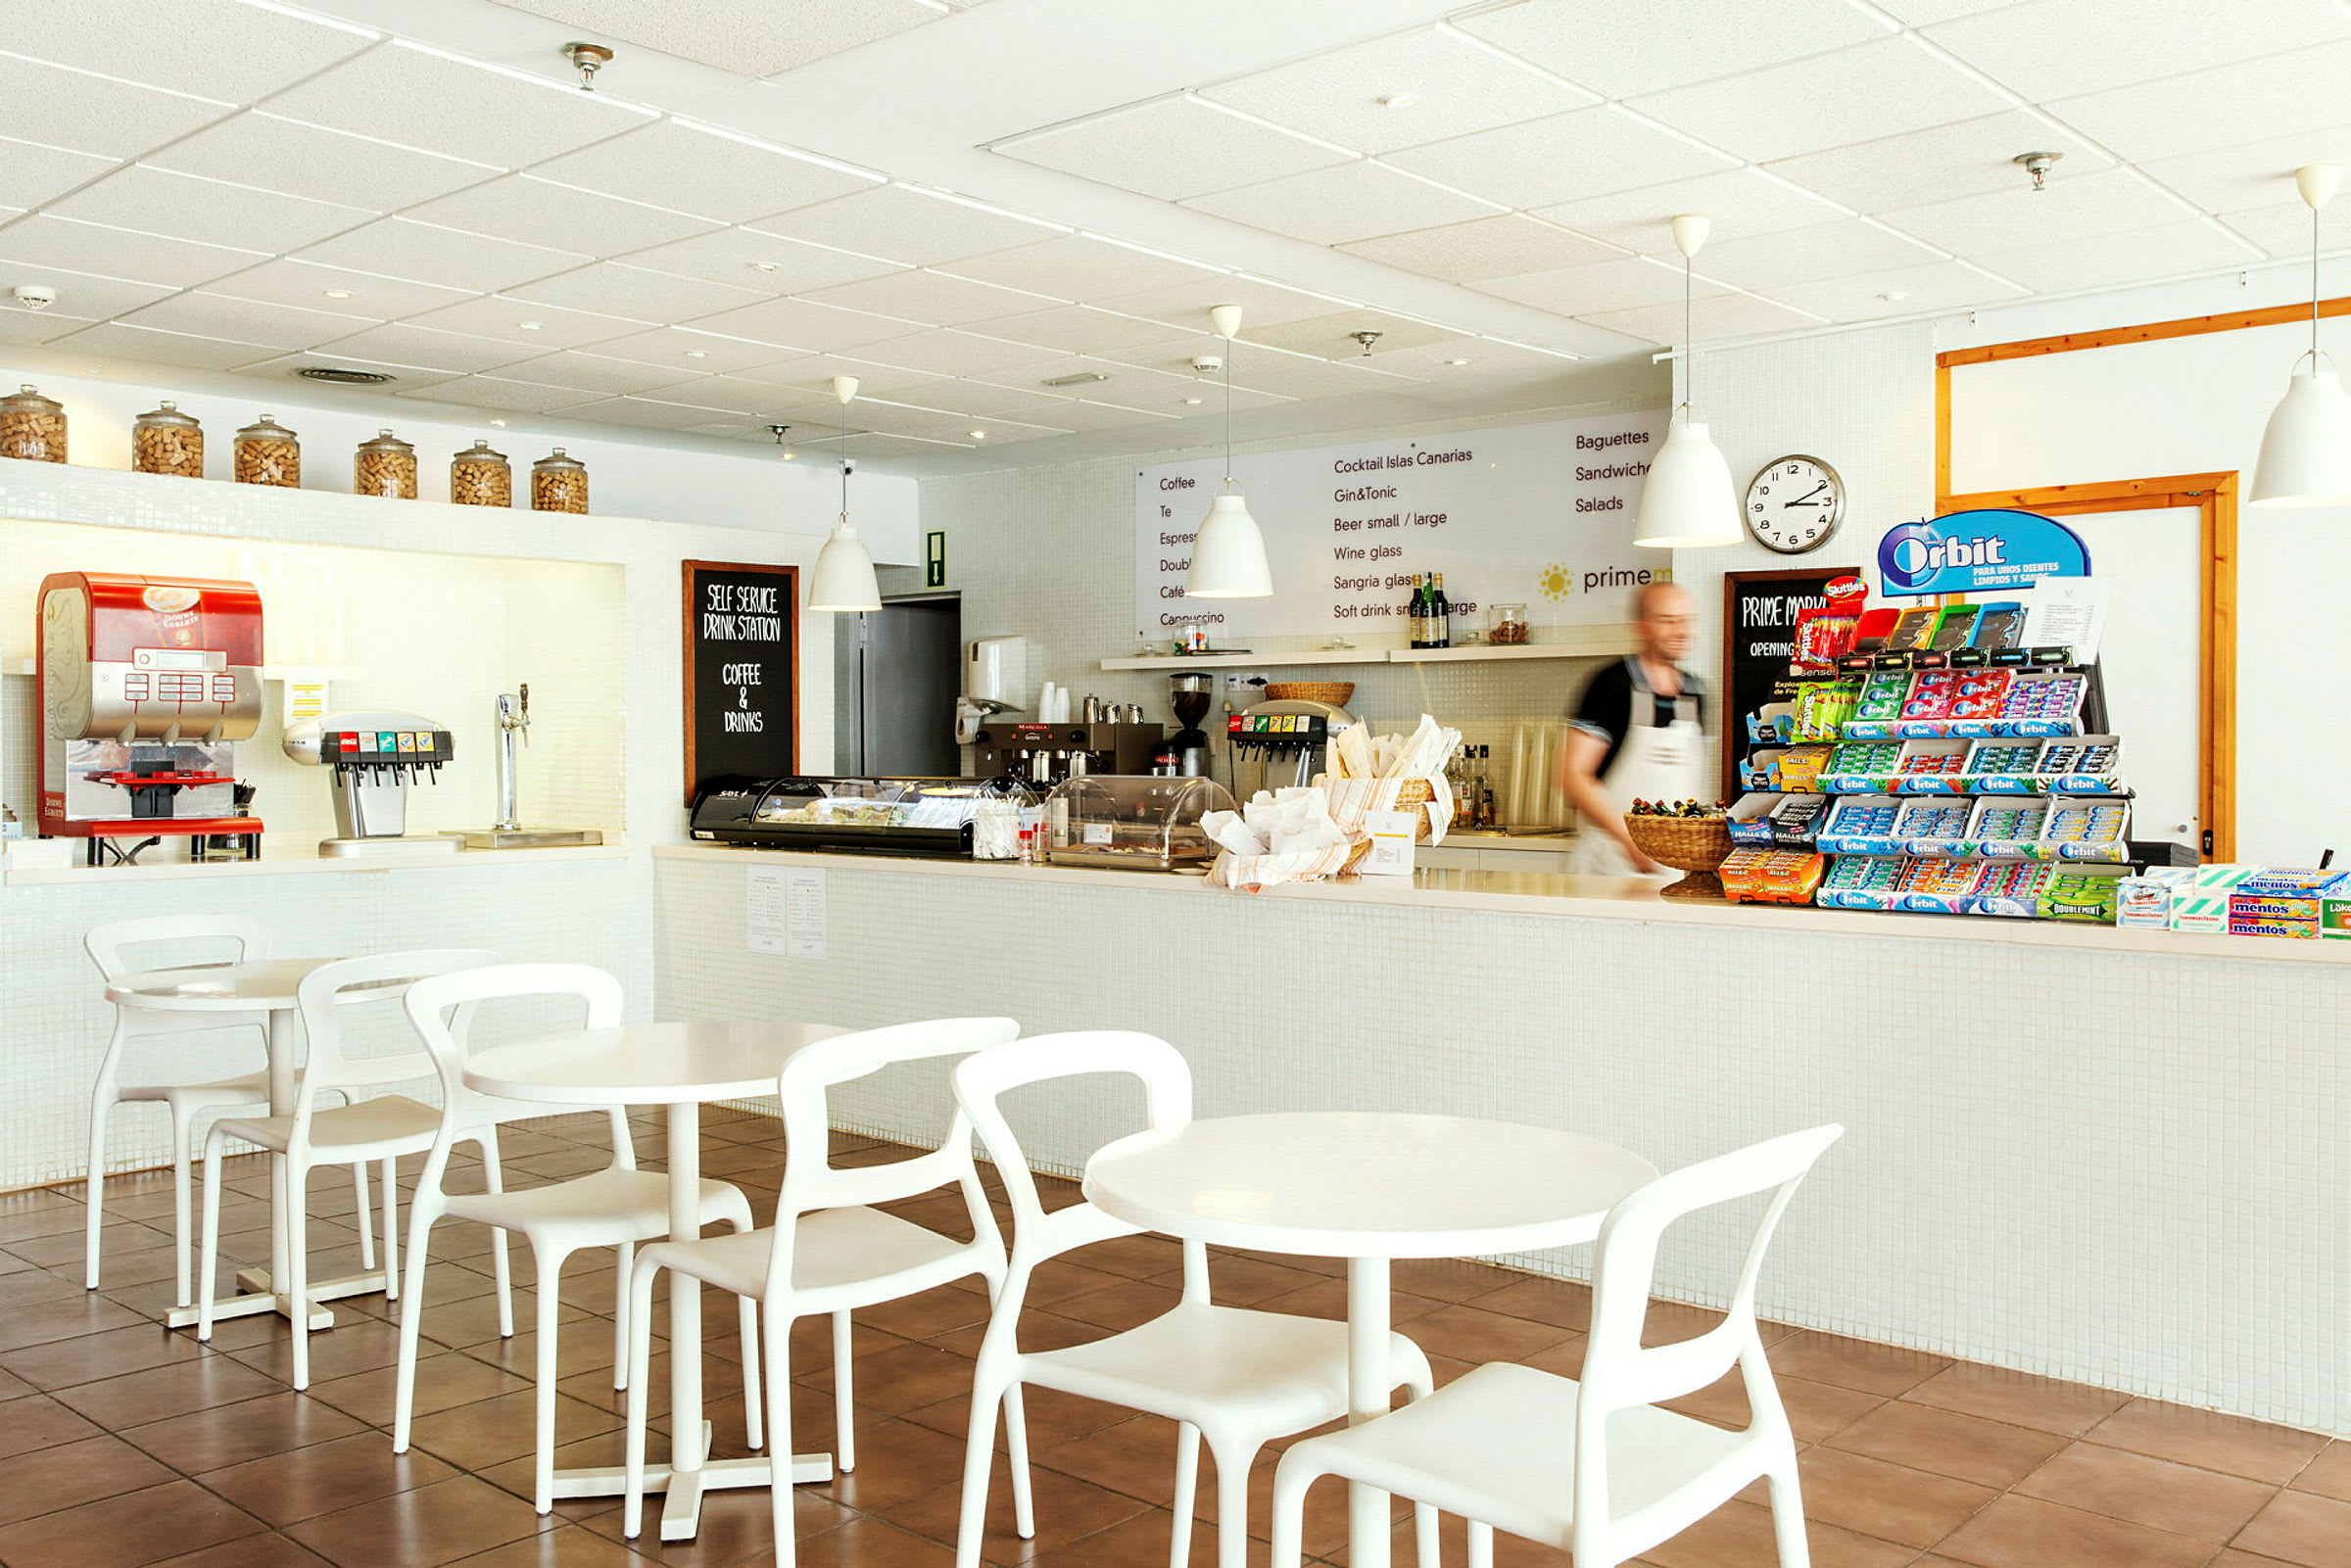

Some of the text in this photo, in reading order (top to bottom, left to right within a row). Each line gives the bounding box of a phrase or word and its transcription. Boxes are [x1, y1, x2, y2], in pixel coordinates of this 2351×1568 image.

[1575, 432, 1650, 451] Baguettes
[1334, 449, 1472, 473] Cocktail Islas Canarias
[1575, 461, 1652, 481] Sandwich
[1787, 465, 1799, 474] 12
[1807, 468, 1811, 477] 1
[1160, 477, 1195, 490] Coffee
[1771, 472, 1778, 482] 11
[1334, 486, 1398, 502] Gin&Tonic
[1759, 486, 1769, 496] 10
[1575, 496, 1624, 512] Salads
[1754, 503, 1764, 512] 9
[1823, 498, 1832, 506] 3
[1160, 505, 1172, 517] Te
[1334, 519, 1363, 532] Beer
[1367, 514, 1400, 529] small
[1414, 512, 1448, 528] large
[1759, 520, 1770, 529] 8
[1818, 514, 1827, 523] 4
[1160, 532, 1198, 546] Espres
[1772, 532, 1781, 542] 7
[1789, 536, 1799, 545] 6
[1805, 529, 1815, 538] 5
[1334, 545, 1403, 561] Wine glass
[1878, 523, 2006, 588] Orbit
[1160, 558, 1192, 572] Doubl
[1973, 566, 1996, 577] PARA
[2022, 561, 2060, 573] DIENTES
[1334, 573, 1412, 592] Sangria glas
[1973, 574, 2011, 587] LIMPIOS
[1160, 587, 1184, 598] Café
[1828, 582, 1865, 597] Skittles
[707, 584, 778, 614] SELF SERVICE
[1334, 604, 1358, 618] Soft
[1361, 603, 1391, 617] drink
[1447, 602, 1477, 616] arge
[1742, 596, 1784, 627] PRIME
[703, 613, 781, 641] DRINK STATION
[1800, 622, 1813, 661] Skittles
[1750, 642, 1795, 656] OPENING
[723, 663, 761, 686] COFFEE
[739, 687, 747, 710] &
[725, 711, 763, 733] DRINKS
[1802, 694, 1814, 736] Skittles
[2251, 880, 2298, 889] mentos
[2054, 904, 2101, 916] DOUBLEMINT
[2233, 903, 2289, 915] mentos
[2232, 924, 2288, 935] mentos
